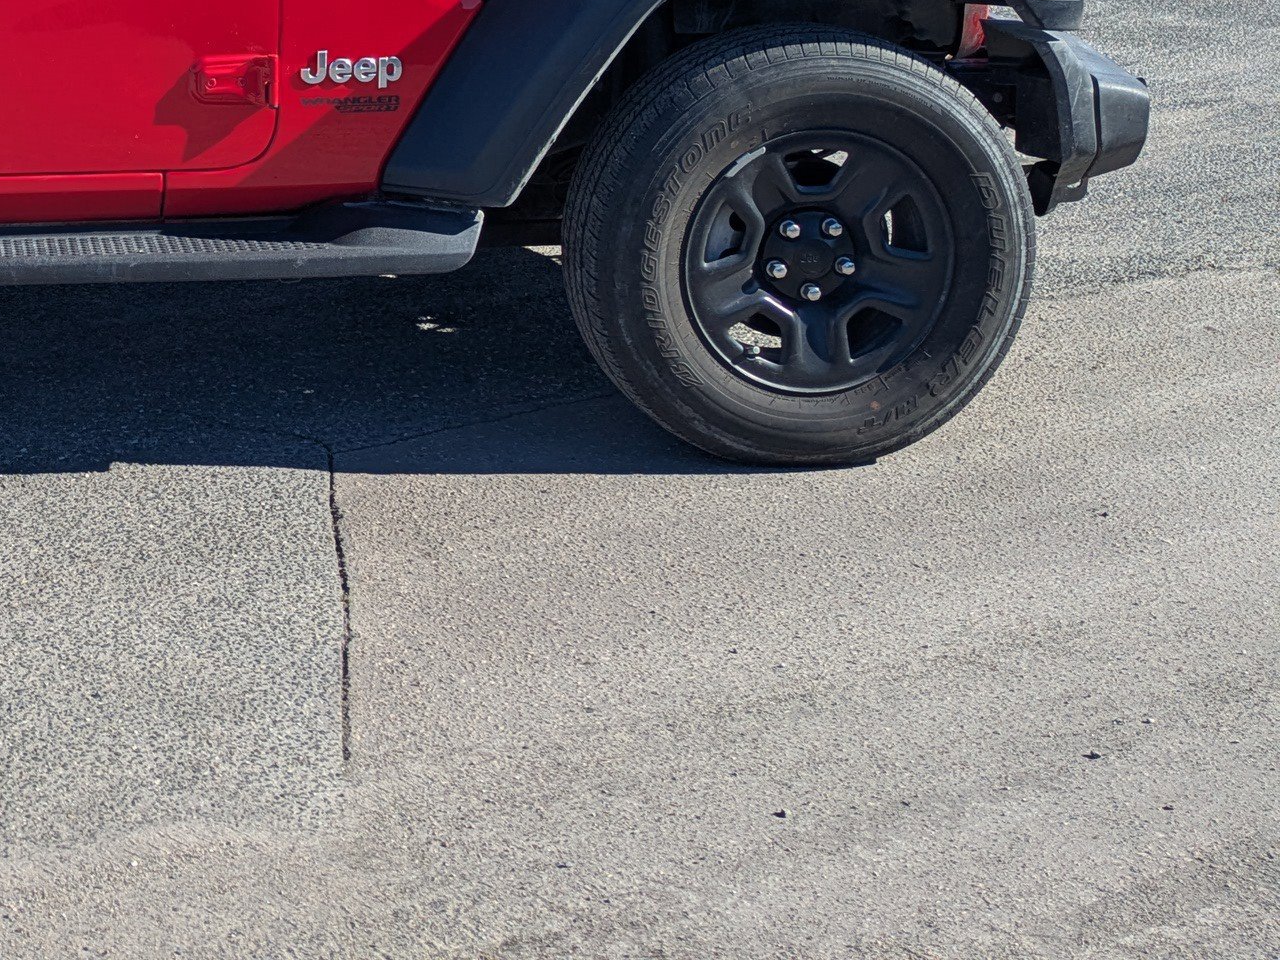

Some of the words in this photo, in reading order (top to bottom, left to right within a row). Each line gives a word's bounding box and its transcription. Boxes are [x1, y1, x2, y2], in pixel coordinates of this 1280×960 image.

[300, 49, 403, 89] Jeep
[640, 100, 753, 387] BRIDGESTONE
[925, 170, 1007, 398] DUELER
